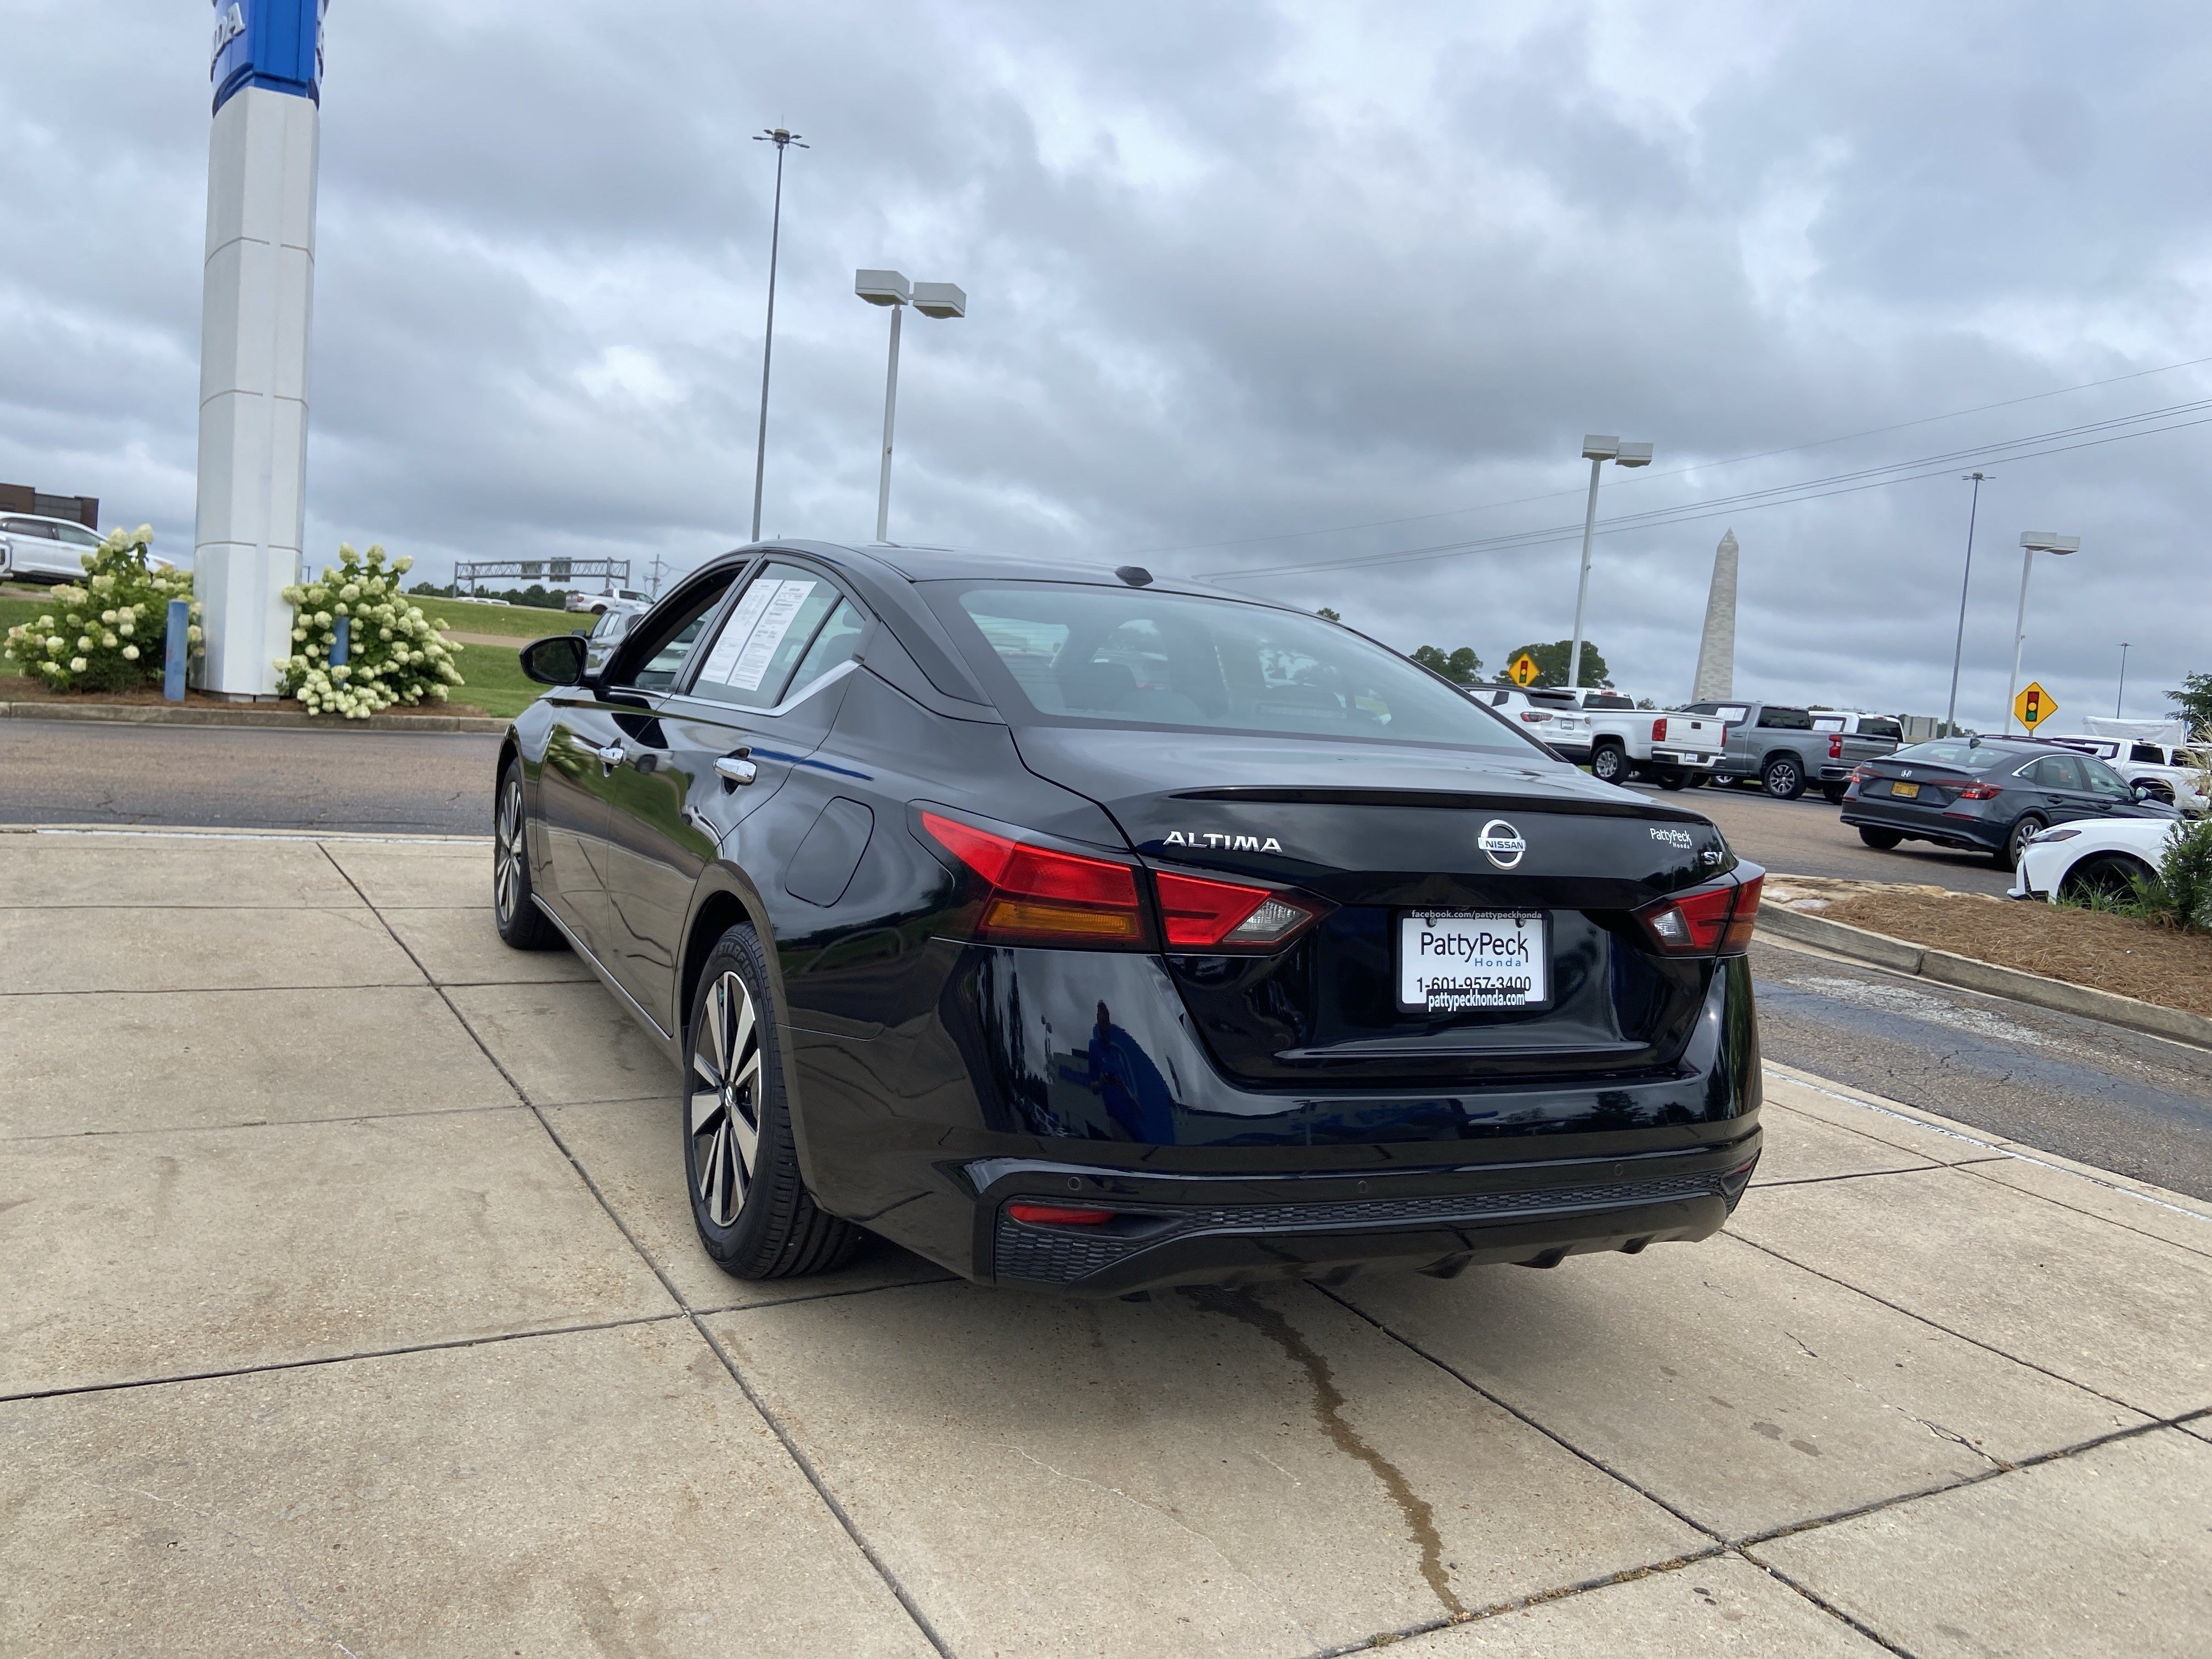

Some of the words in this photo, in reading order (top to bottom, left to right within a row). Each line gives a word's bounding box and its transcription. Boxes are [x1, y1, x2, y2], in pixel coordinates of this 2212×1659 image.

[1163, 831, 1283, 853] ALTIMA
[1485, 840, 1523, 849] NISSAN
[1650, 828, 1692, 846] PattyPeck
[1703, 851, 1723, 865] SV
[1412, 910, 1542, 919] facebook.com/pattypeckhonda
[1420, 931, 1528, 963] PattyPeck
[1475, 957, 1521, 967] Honda
[1417, 977, 1531, 992] 1-601-957-3400
[1428, 989, 1525, 1012] pattypeckhonda.com
